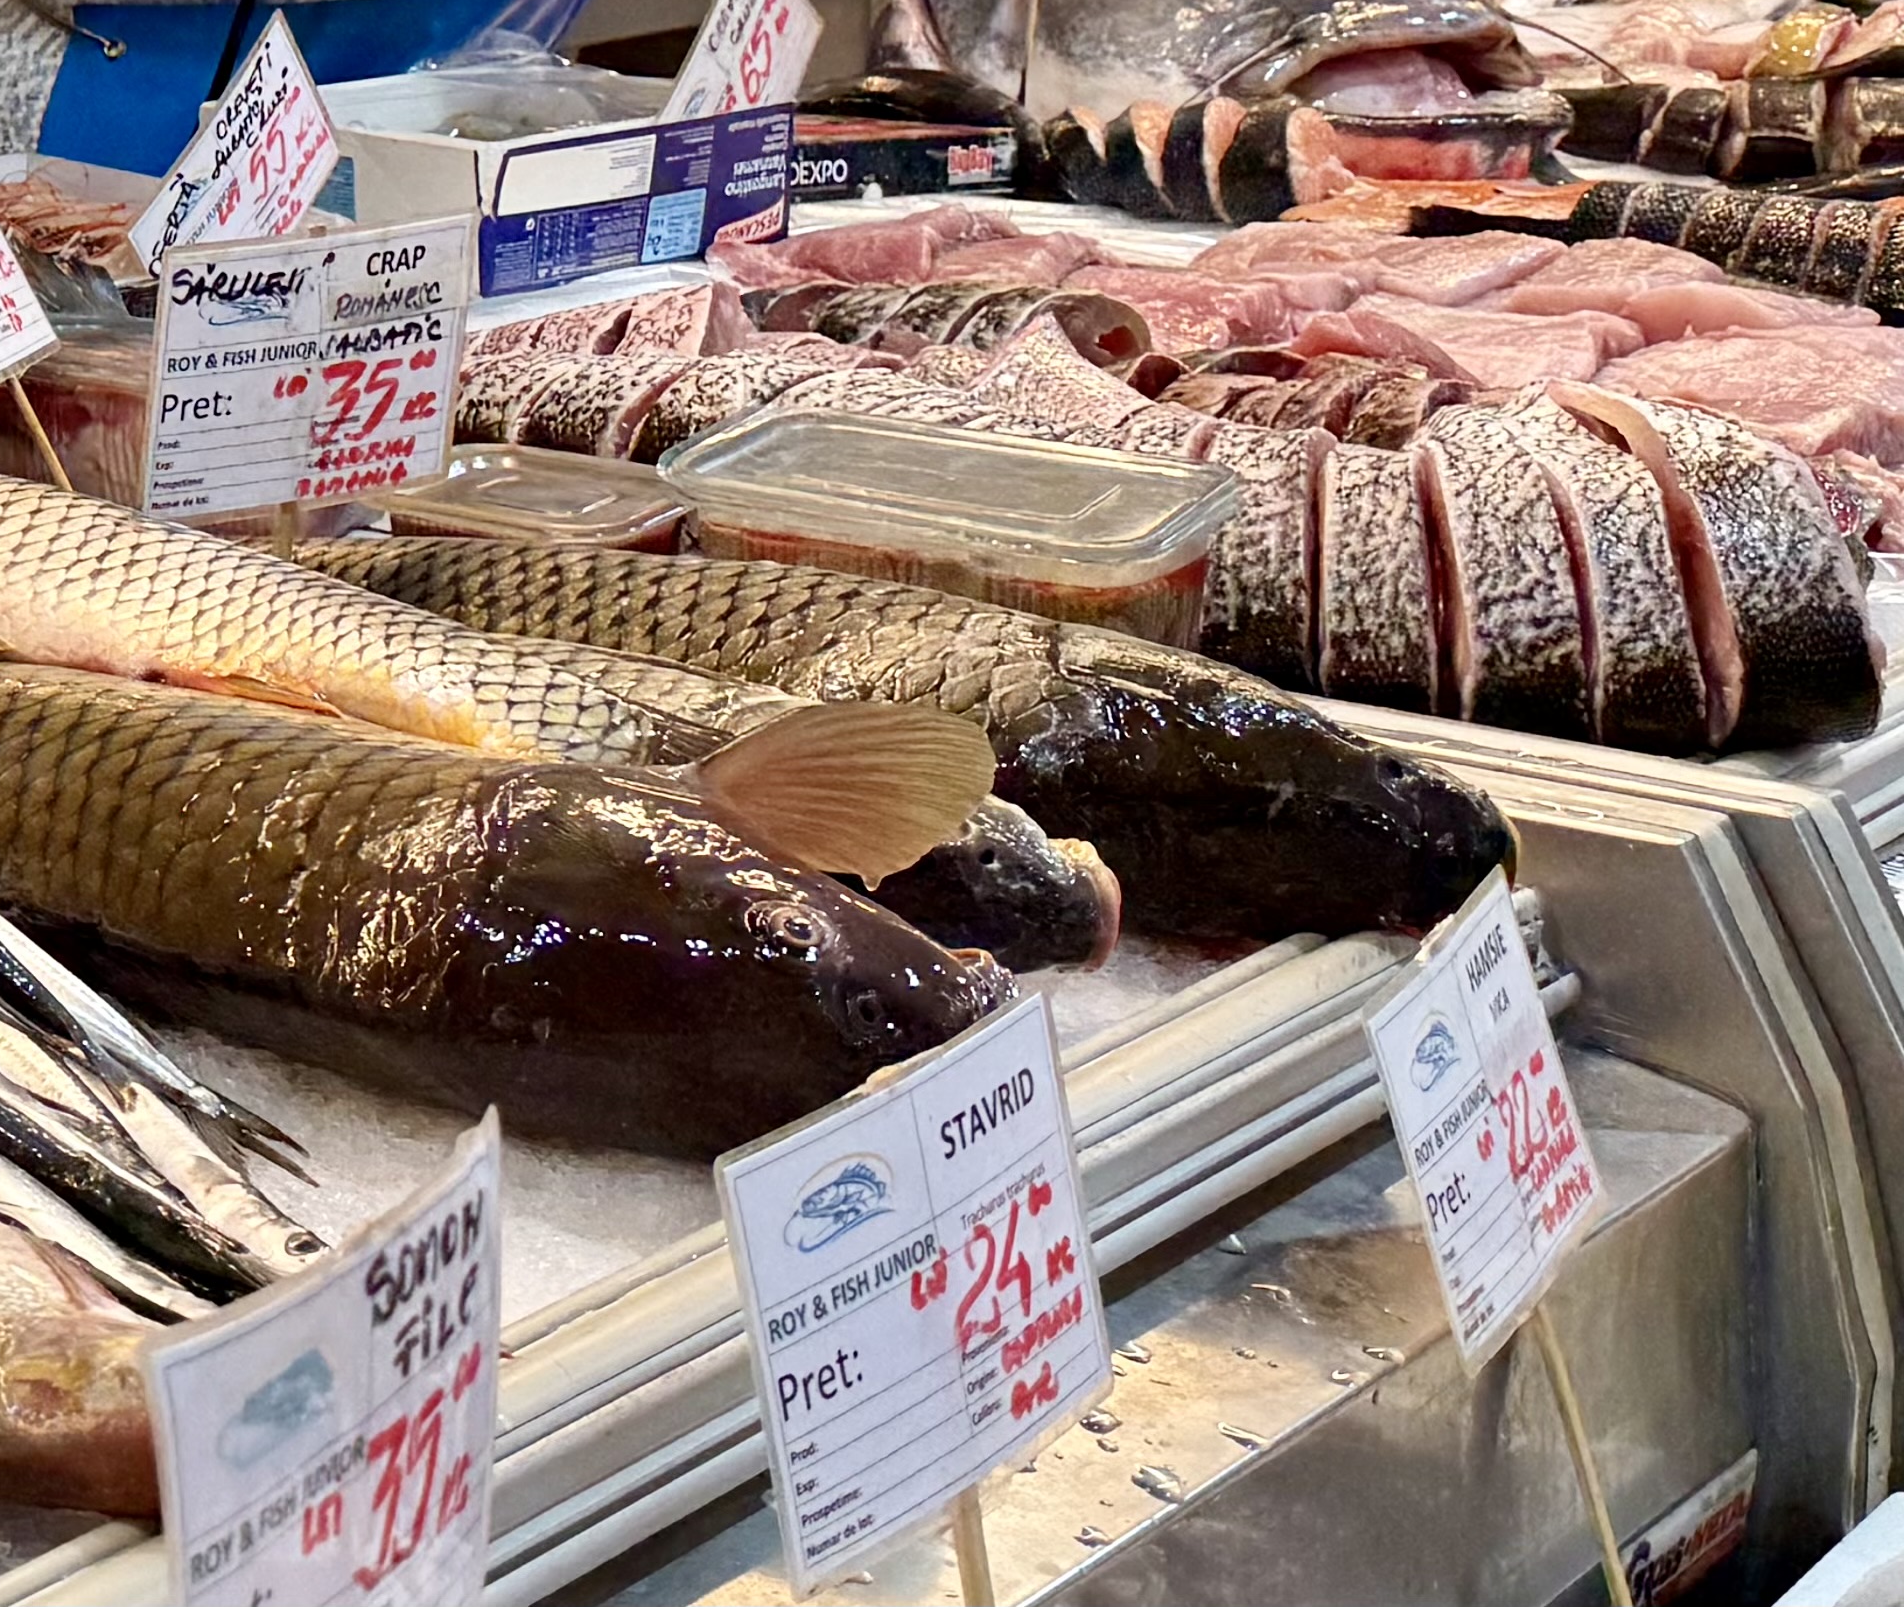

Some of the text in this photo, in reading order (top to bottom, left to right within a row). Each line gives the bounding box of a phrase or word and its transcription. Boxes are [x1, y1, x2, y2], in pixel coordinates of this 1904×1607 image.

[366, 246, 426, 276] CRAP
[167, 342, 317, 373] ROY & FISH JUNIOR
[160, 391, 232, 423] Pret:
[310, 359, 404, 445] 35
[1465, 923, 1507, 994] HAMSIE
[940, 1067, 1035, 1161] STAVRID
[1415, 1139, 1434, 1167] ROY
[1443, 1111, 1462, 1137] FISH
[1493, 1070, 1548, 1184] 22
[1427, 1174, 1472, 1231] Pret:
[365, 1188, 483, 1328] SOMON
[769, 1234, 937, 1344] ROY & FISH JUNIOR
[955, 1199, 1031, 1352] 24
[778, 1346, 863, 1422] Pret:
[791, 1442, 819, 1465] Prod:
[796, 1477, 819, 1496] Exp:
[191, 1434, 366, 1580] ROY & FISH JUNIOR
[807, 1531, 841, 1559] Numar
[844, 1522, 856, 1538] de
